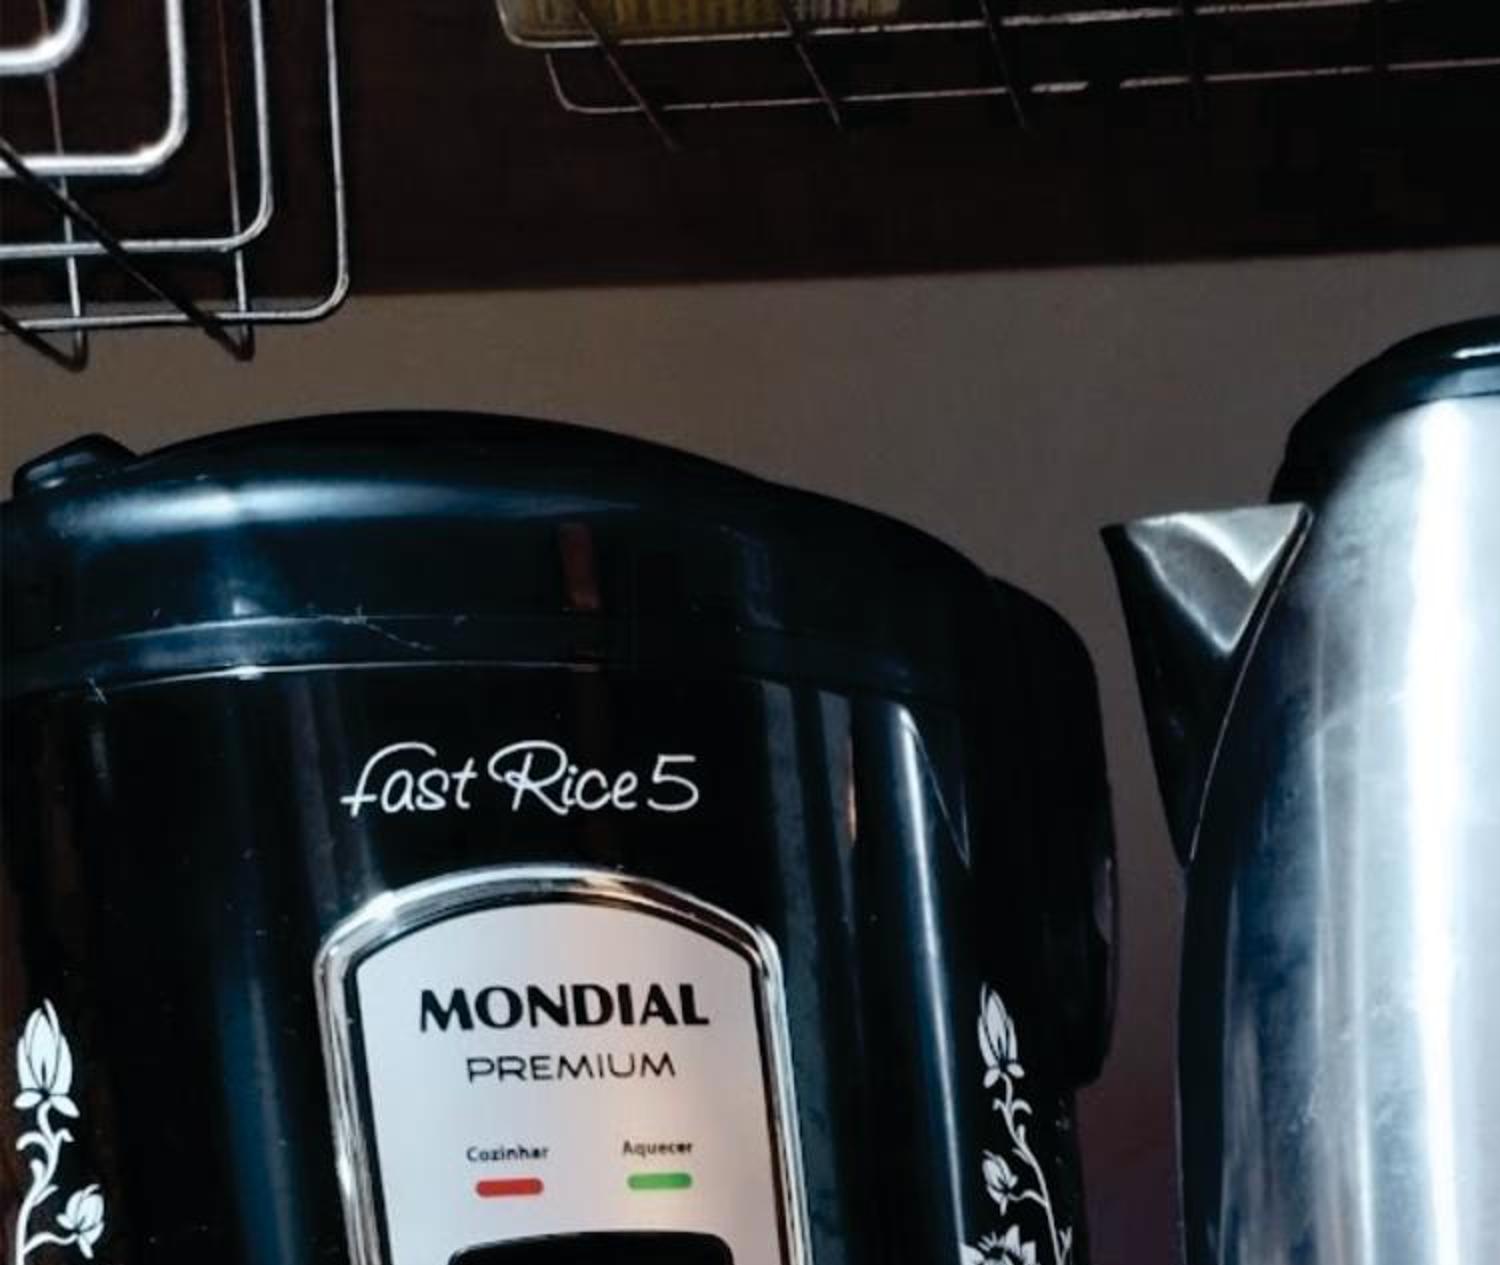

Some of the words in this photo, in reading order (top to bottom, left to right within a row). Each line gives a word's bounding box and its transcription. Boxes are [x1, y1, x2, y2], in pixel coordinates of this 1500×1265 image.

[419, 982, 711, 1033] MONDIAL
[466, 1051, 677, 1084] PREMIUM
[465, 1145, 549, 1162] Cozinhar
[622, 1139, 694, 1159] Aquecer
